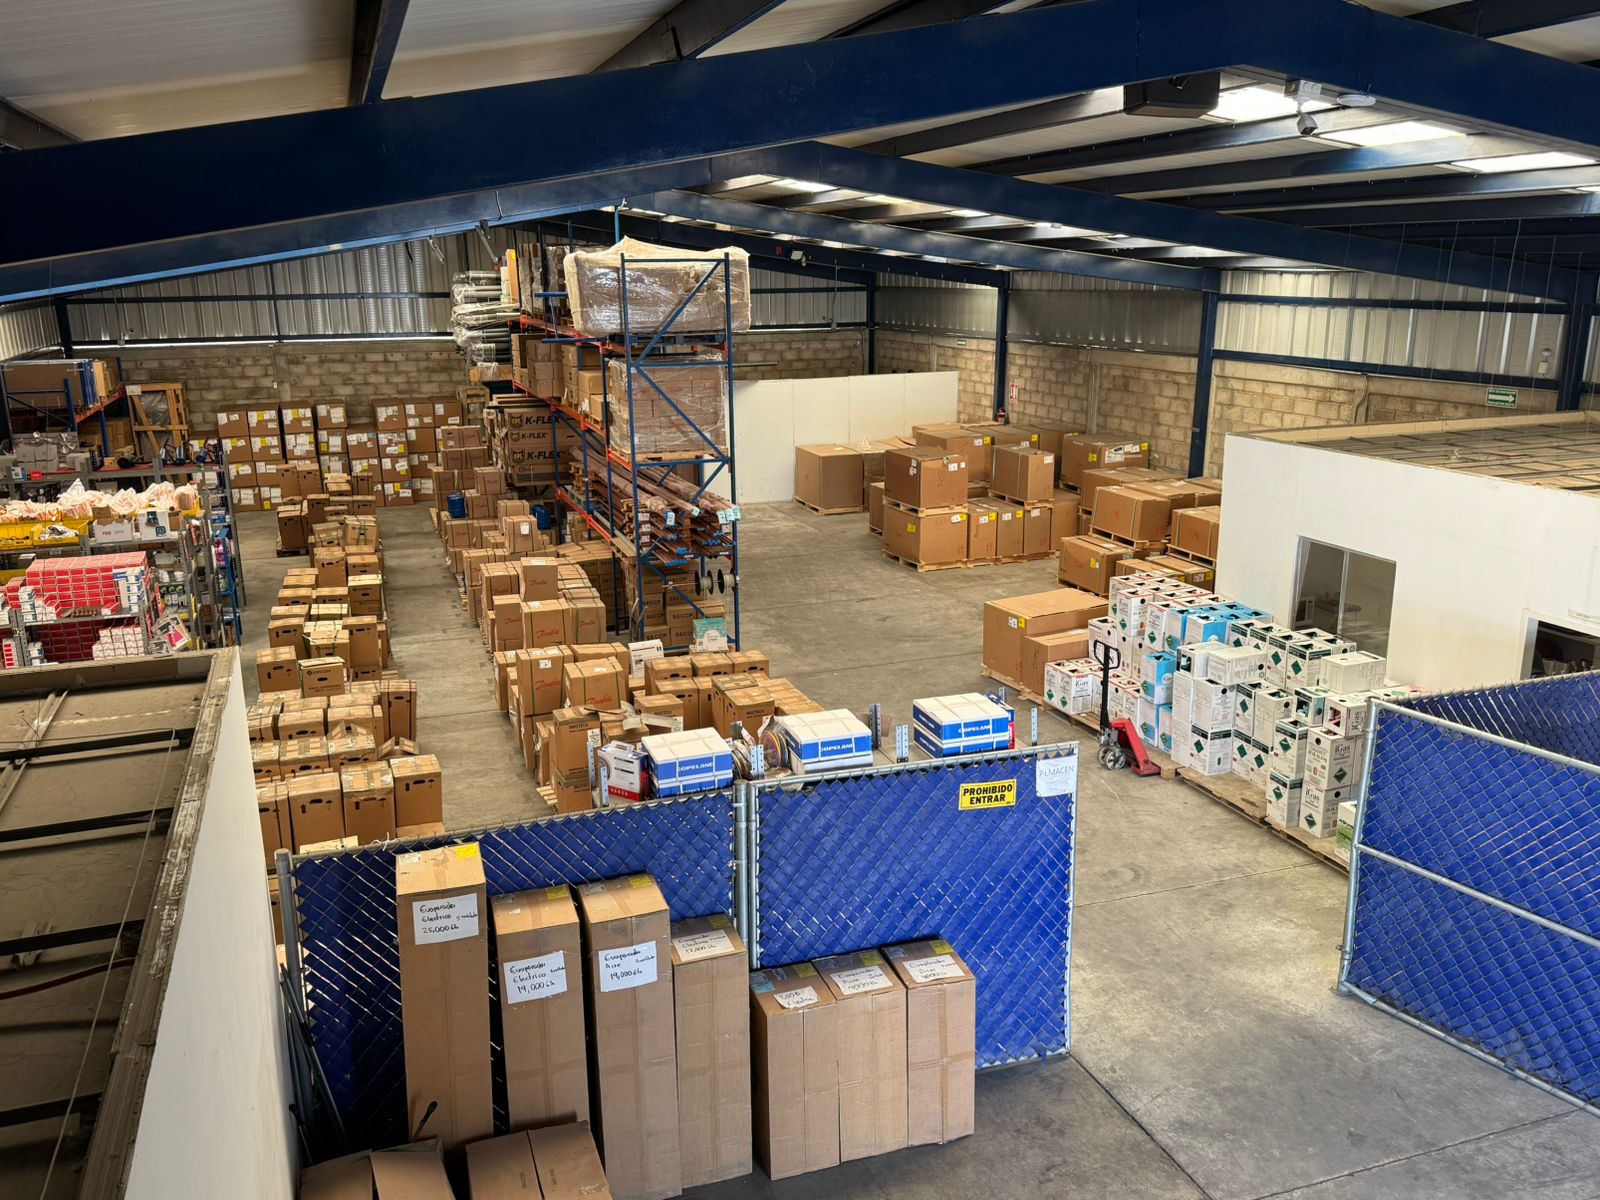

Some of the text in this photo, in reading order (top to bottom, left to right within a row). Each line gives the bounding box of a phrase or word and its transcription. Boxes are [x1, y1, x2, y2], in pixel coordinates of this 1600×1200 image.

[1040, 765, 1075, 778] ALMACEN
[963, 783, 1013, 797] PROHIBIDO
[969, 794, 1006, 805] ENTRAR
